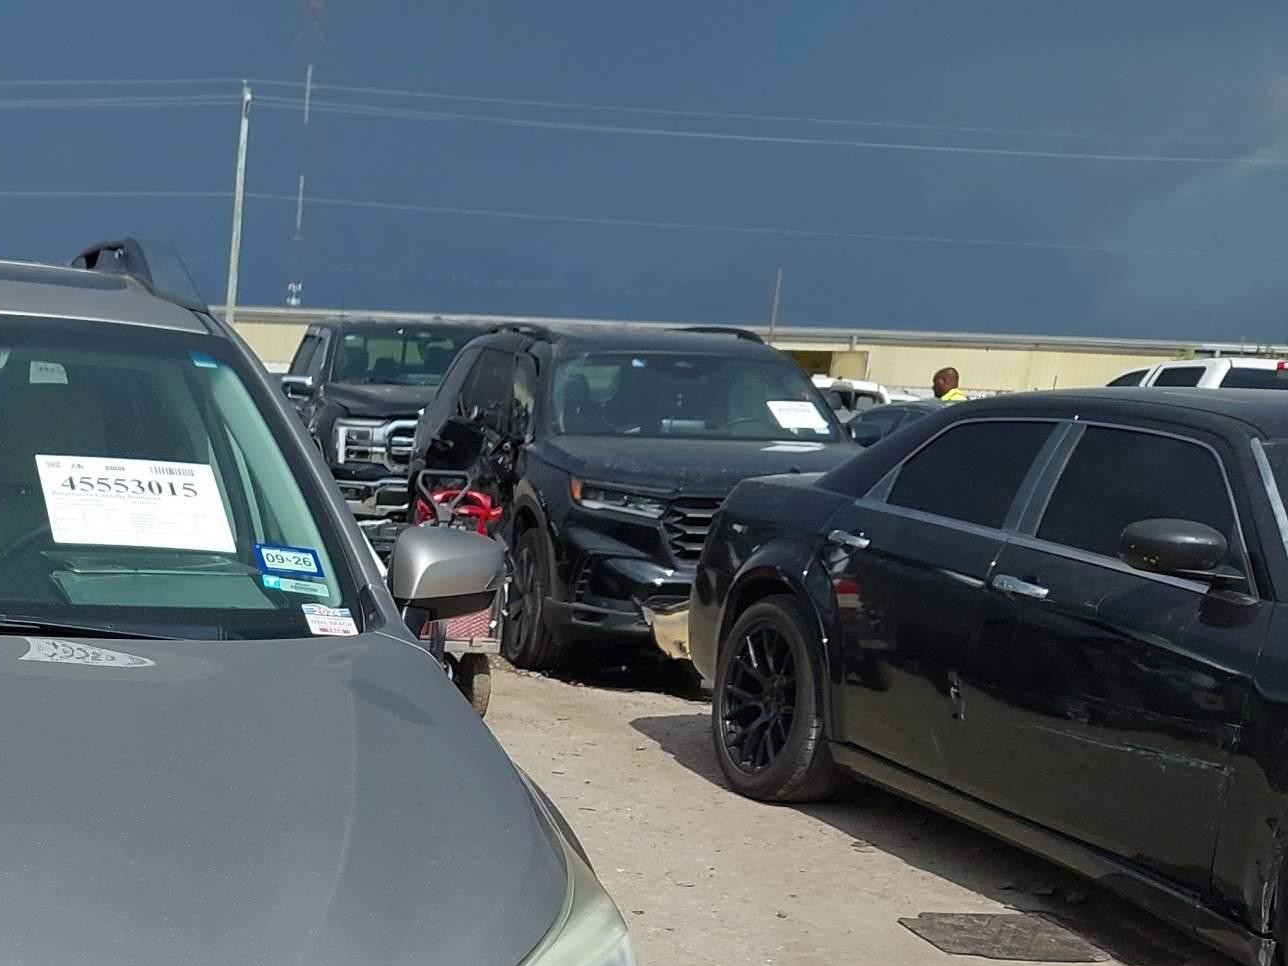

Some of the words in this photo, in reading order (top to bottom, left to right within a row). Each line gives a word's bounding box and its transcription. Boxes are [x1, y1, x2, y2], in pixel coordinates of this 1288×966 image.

[61, 476, 198, 498] 45553015
[265, 553, 285, 564] 09
[292, 556, 312, 567] 26
